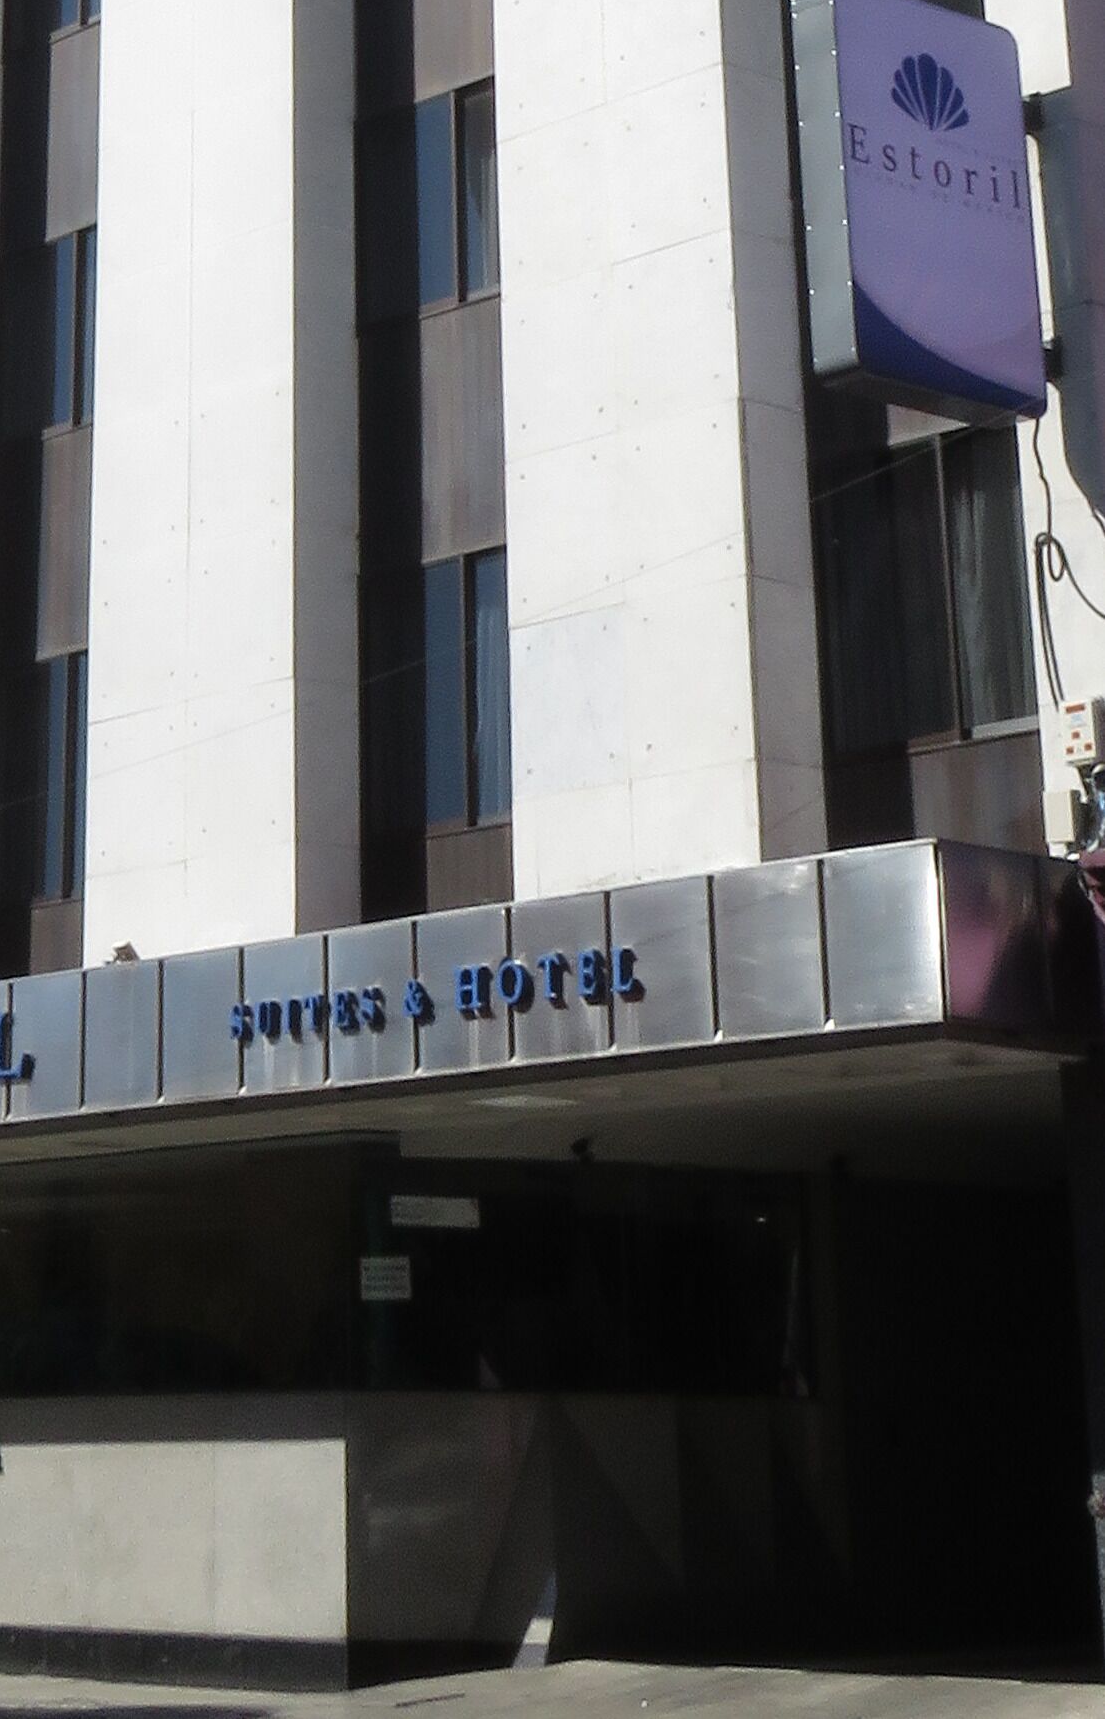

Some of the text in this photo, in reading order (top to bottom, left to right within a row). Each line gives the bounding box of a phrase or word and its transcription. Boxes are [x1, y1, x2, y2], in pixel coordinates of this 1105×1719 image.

[847, 121, 1022, 210] Estoril
[230, 946, 641, 1041] SUITES & HOTEL
